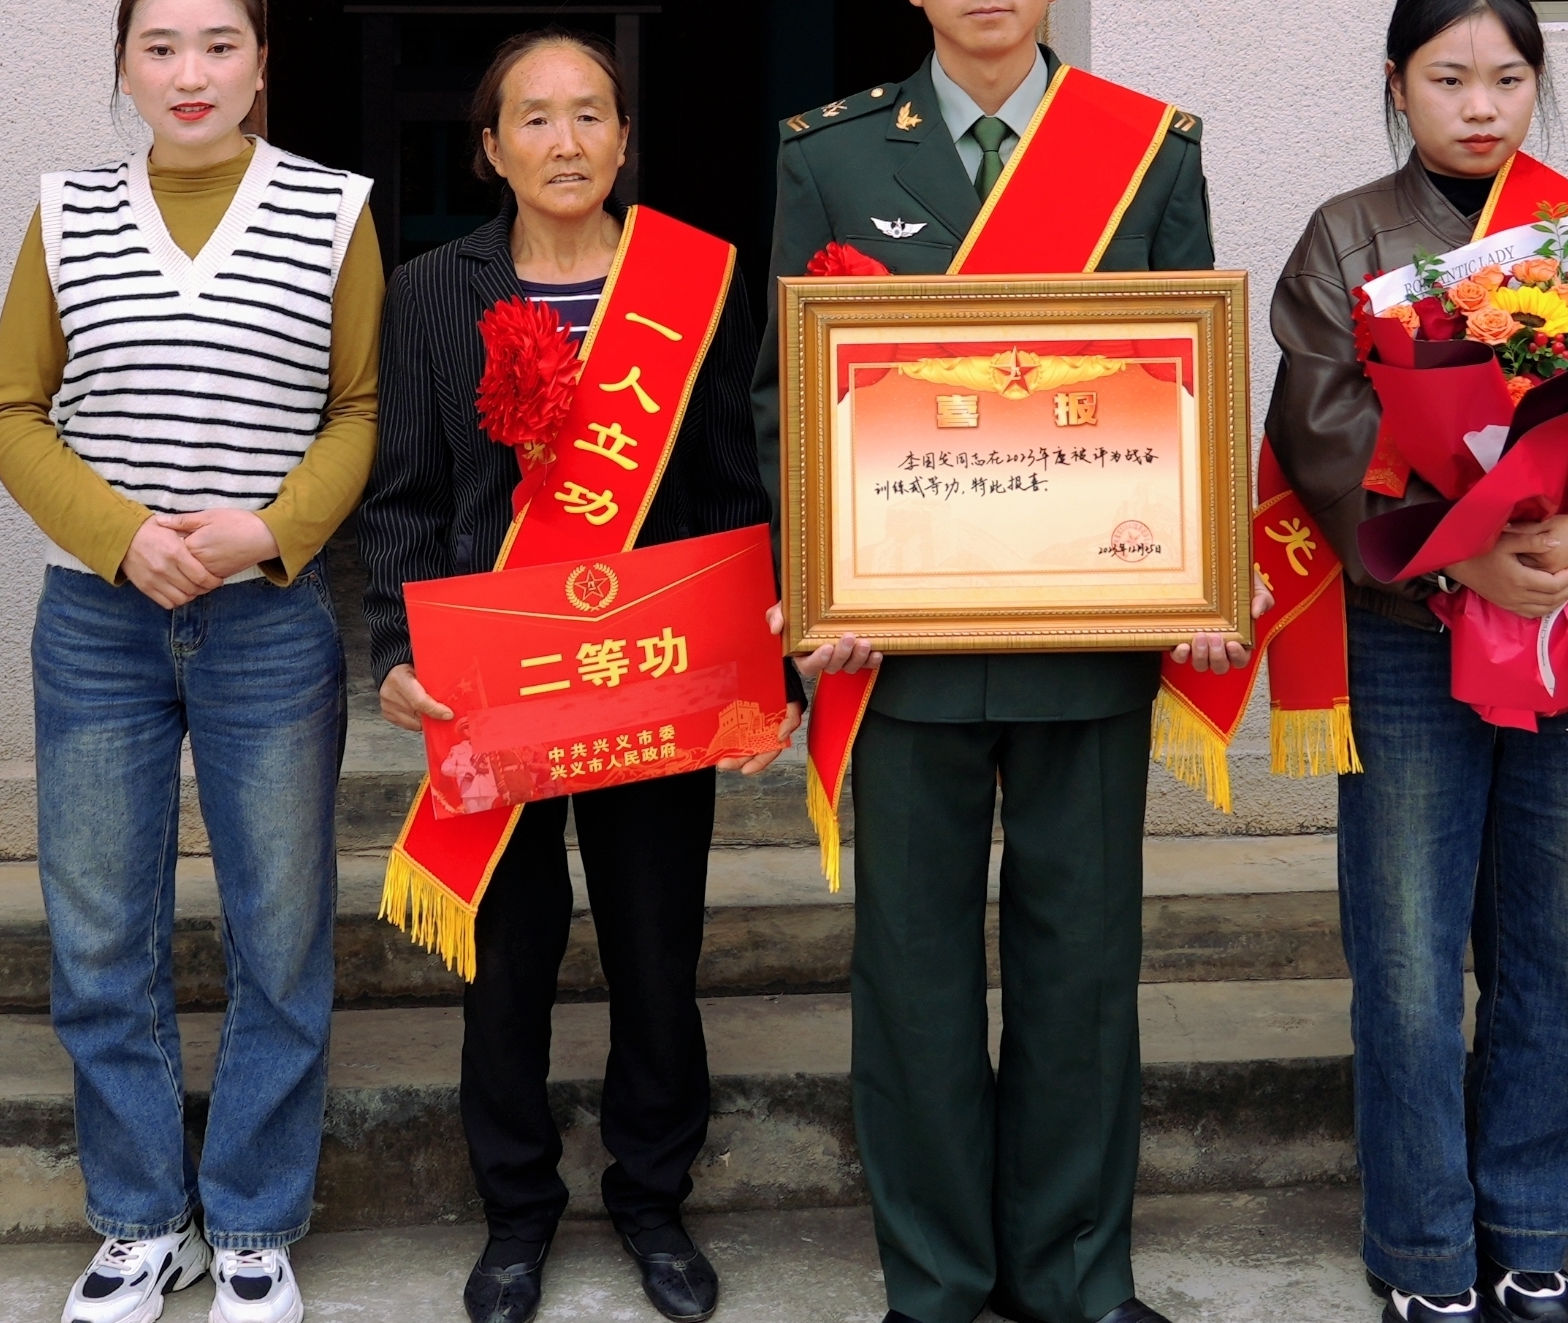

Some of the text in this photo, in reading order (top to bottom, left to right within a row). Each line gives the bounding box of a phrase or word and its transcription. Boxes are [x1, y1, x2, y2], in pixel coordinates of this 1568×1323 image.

[554, 312, 683, 526] 一人立功
[936, 392, 1098, 429] 喜报
[519, 627, 689, 696] 二等功
[548, 724, 677, 763] 中共兴义市委
[550, 742, 677, 781] 兴义市人民政府
